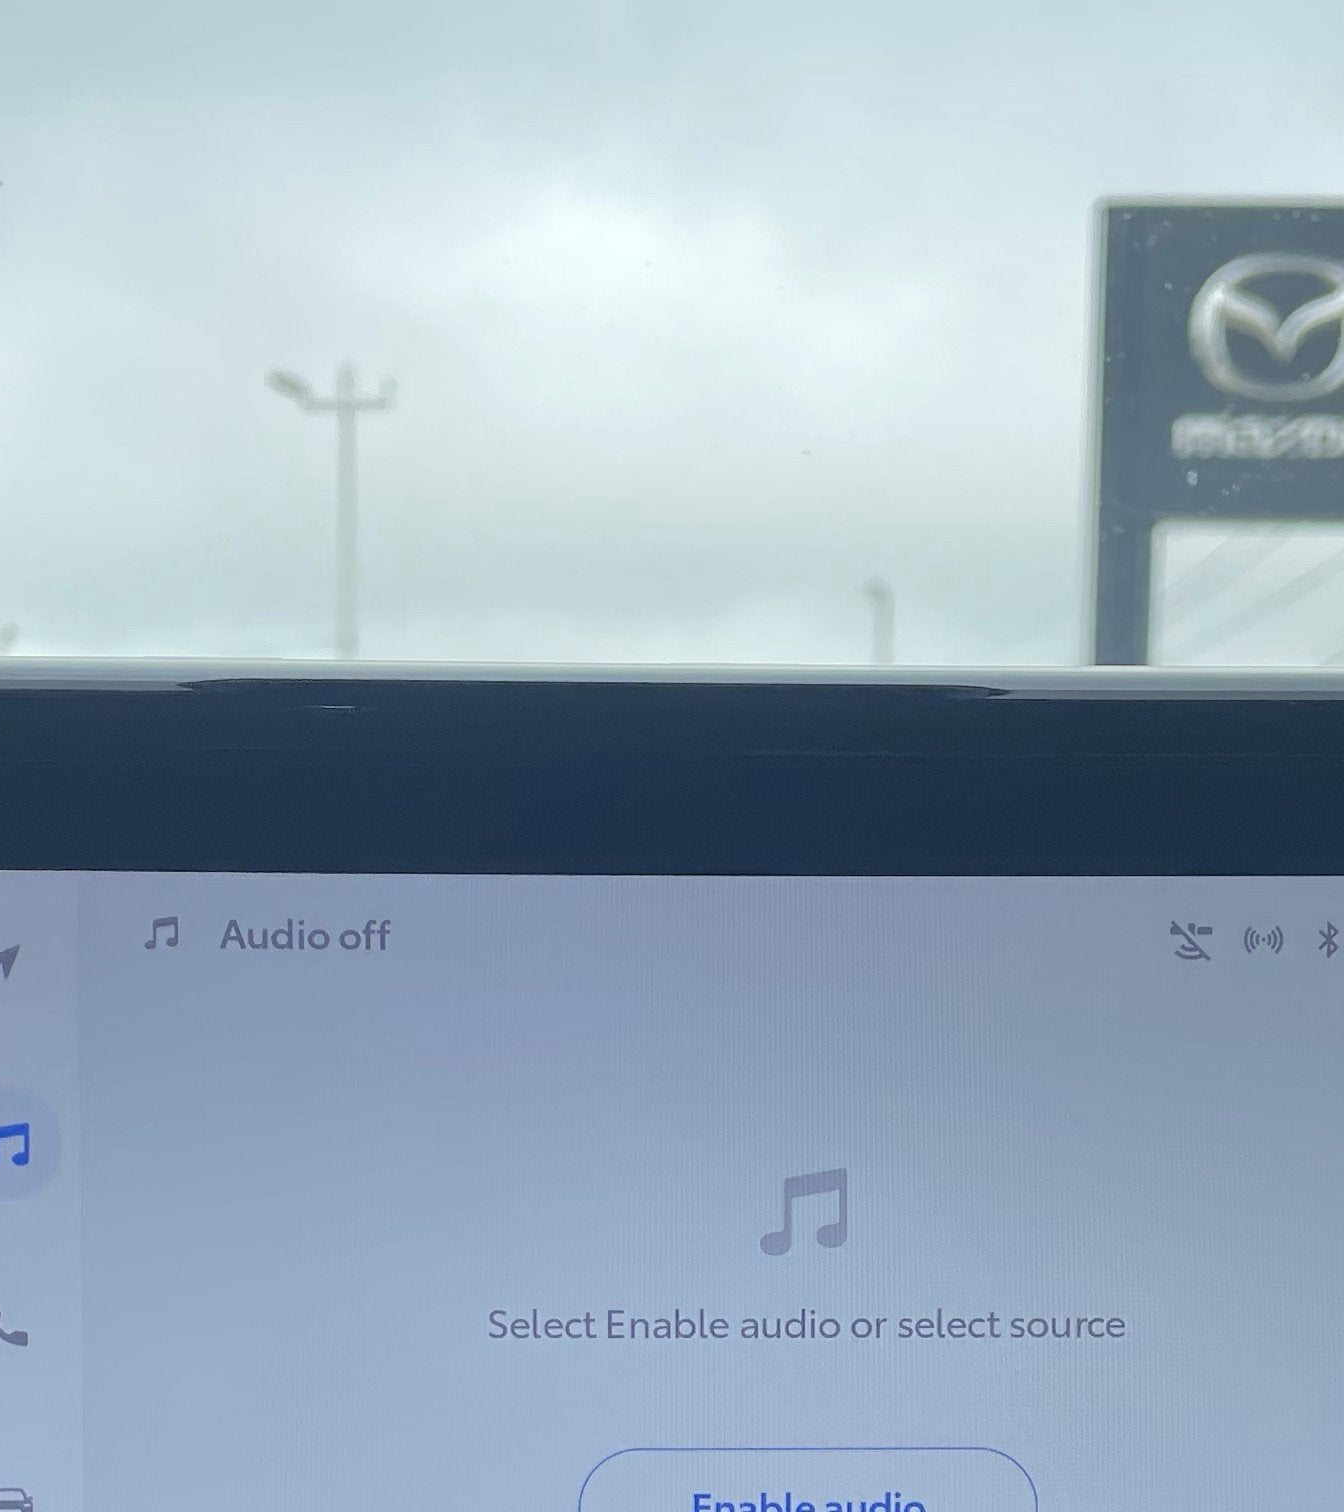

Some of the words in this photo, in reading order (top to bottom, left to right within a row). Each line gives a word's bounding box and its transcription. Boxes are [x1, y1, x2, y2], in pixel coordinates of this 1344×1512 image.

[220, 918, 330, 951] Audio
[339, 919, 392, 951] off
[488, 1308, 597, 1339] Select
[607, 1308, 729, 1339] Enable
[740, 1308, 841, 1339] audio
[850, 1317, 887, 1339] or
[898, 1307, 1001, 1339] select
[1010, 1316, 1126, 1339] source
